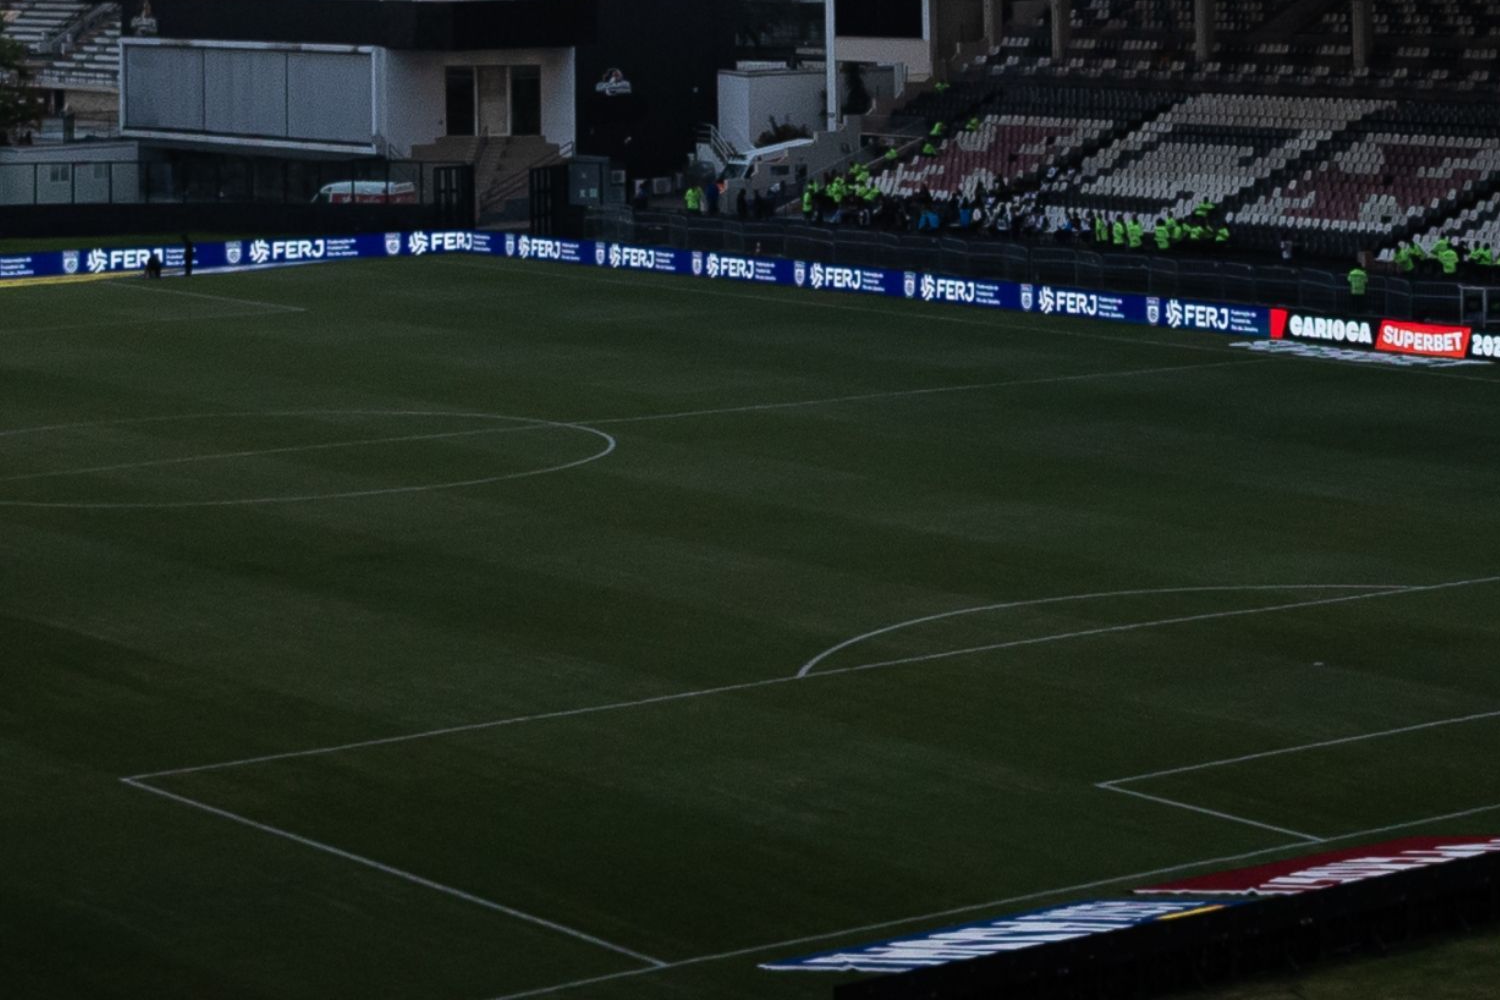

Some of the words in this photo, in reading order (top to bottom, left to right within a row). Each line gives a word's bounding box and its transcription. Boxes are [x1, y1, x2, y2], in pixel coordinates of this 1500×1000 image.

[273, 239, 325, 259] FERJ
[431, 231, 472, 251] FERJ
[529, 239, 561, 259] FERJ
[622, 248, 655, 268] FERJ
[720, 257, 754, 279] FERJ
[825, 267, 861, 290] FERJ
[936, 281, 975, 303] FERJ
[1056, 291, 1097, 316] FERJ
[1184, 304, 1228, 330] FERJ
[1289, 315, 1373, 344] CARIOCA
[1382, 325, 1463, 352] SUPERBET
